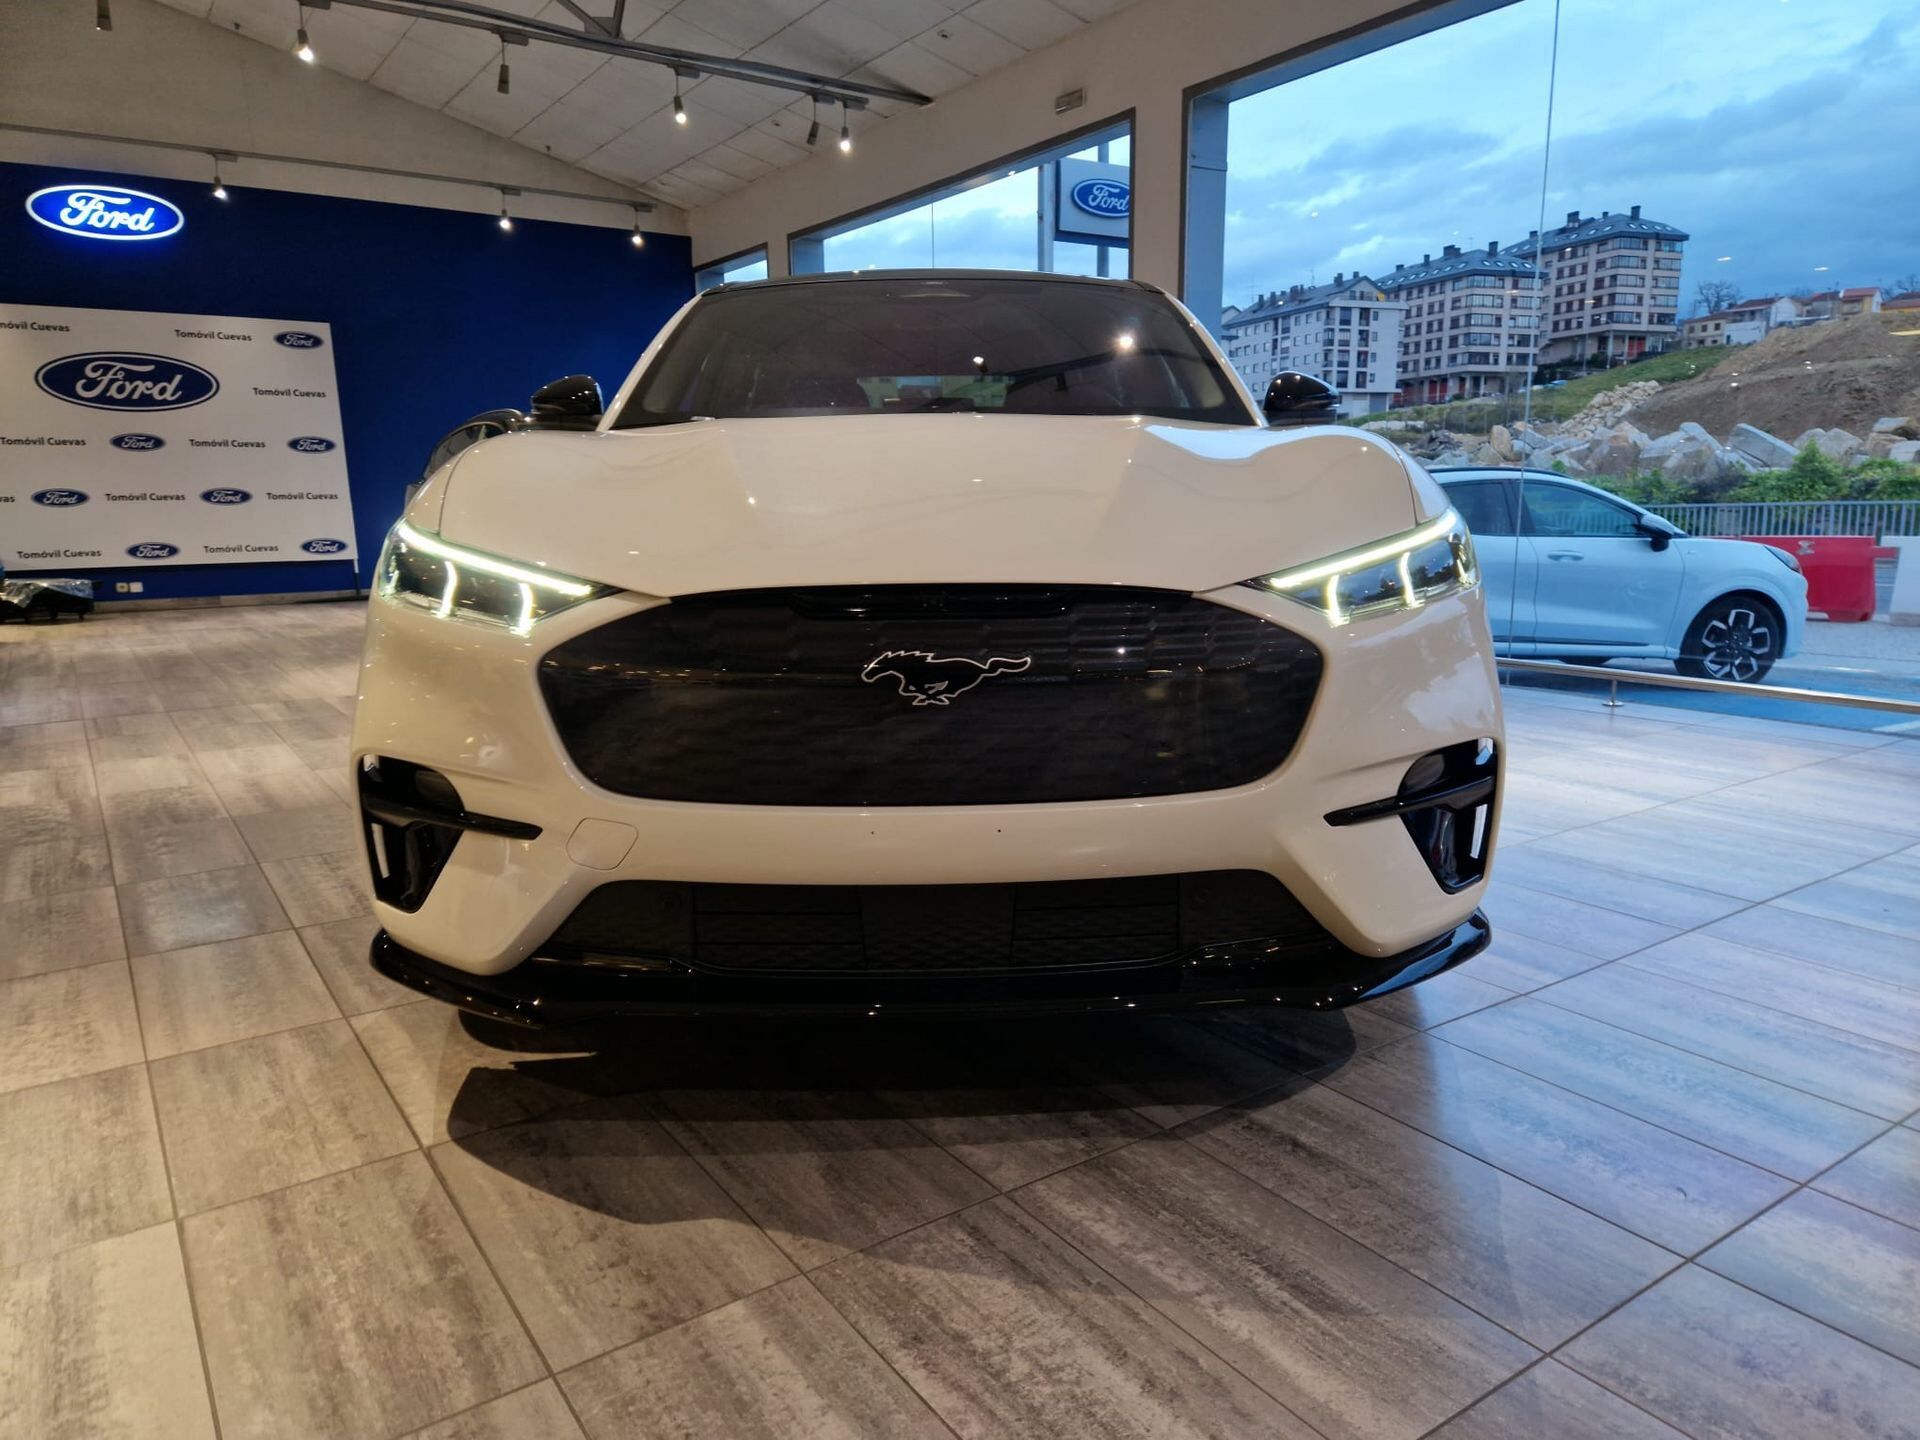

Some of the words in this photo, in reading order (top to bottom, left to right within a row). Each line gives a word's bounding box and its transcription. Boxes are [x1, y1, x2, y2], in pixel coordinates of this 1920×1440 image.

[1088, 185, 1129, 211] Ford
[59, 191, 155, 232] Ford
[0, 320, 28, 331] móvil
[30, 322, 70, 332] Cuevas
[175, 329, 215, 340] Tomóvil
[217, 332, 252, 342] Cuevas
[283, 333, 314, 347] Ford
[75, 360, 183, 401] Ford
[252, 387, 291, 398] Tomóvil
[292, 389, 326, 398] Cuevas
[0, 436, 44, 446] Tomóvil
[47, 437, 86, 446] Cuevas
[121, 435, 155, 449] Ford
[190, 438, 230, 448] Tomóvil
[231, 440, 266, 448] Cuevas
[298, 439, 327, 451] Ford
[44, 491, 78, 505] Ford
[105, 492, 148, 502] Tomóvil
[149, 492, 186, 502] Cuevas
[211, 490, 242, 504] Ford
[266, 491, 304, 501] Tomóvil
[305, 492, 338, 500] Cuevas
[137, 544, 169, 558] Ford
[204, 544, 243, 553] Tomóvil
[244, 544, 278, 553] Cuevas
[310, 540, 338, 553] Ford
[17, 549, 61, 560] Tomóvil
[63, 549, 102, 559] Cuevas
